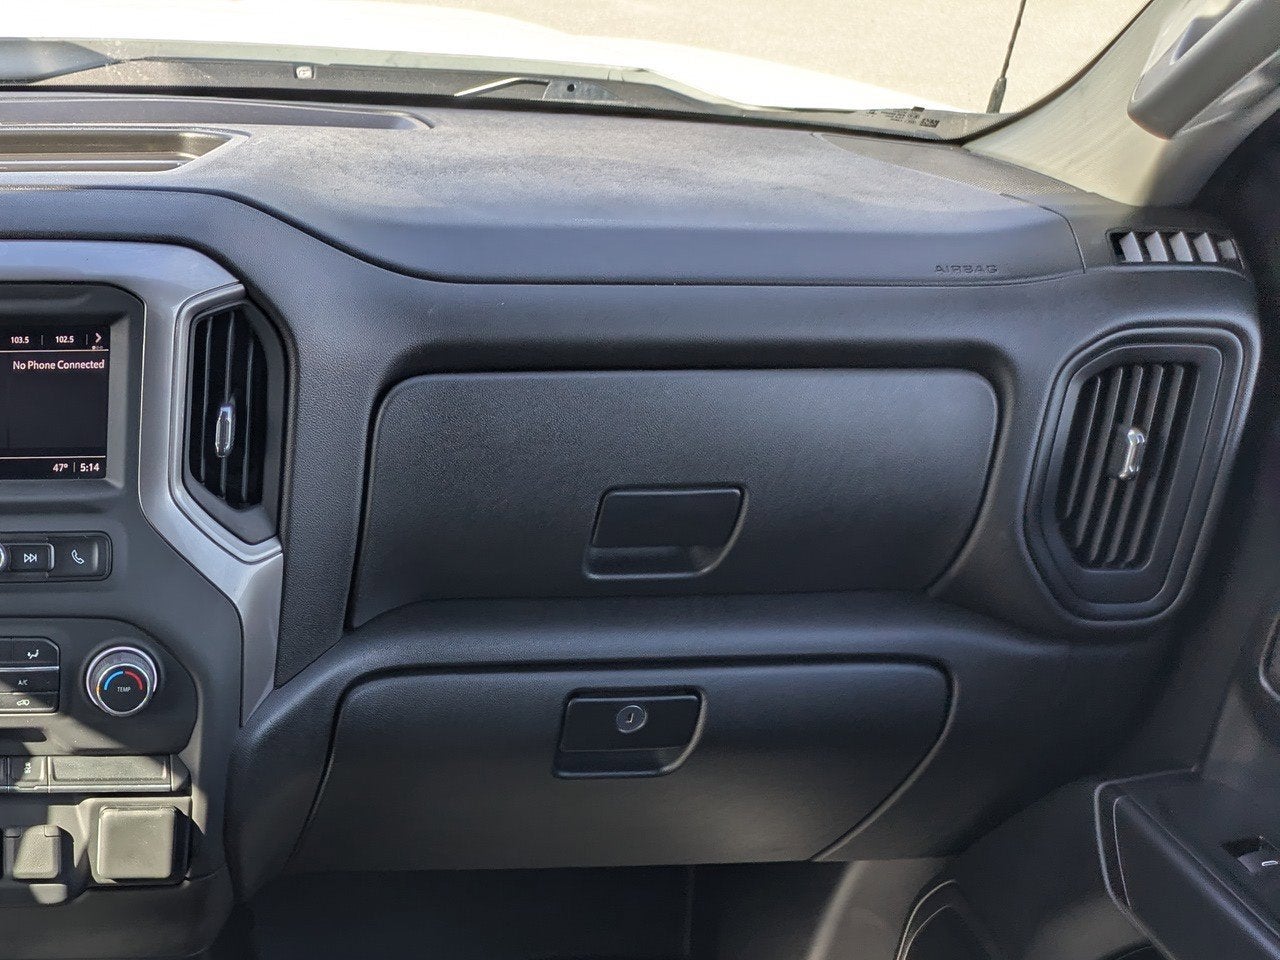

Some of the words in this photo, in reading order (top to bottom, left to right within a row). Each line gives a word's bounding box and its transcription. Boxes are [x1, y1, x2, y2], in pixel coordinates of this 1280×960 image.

[934, 264, 998, 274] AIRBAG
[10, 336, 30, 344] 103.5
[55, 335, 75, 344] 102.5
[12, 360, 27, 370] No
[27, 360, 56, 370] Phone
[57, 359, 105, 370] Connected
[80, 462, 100, 472] 5:14
